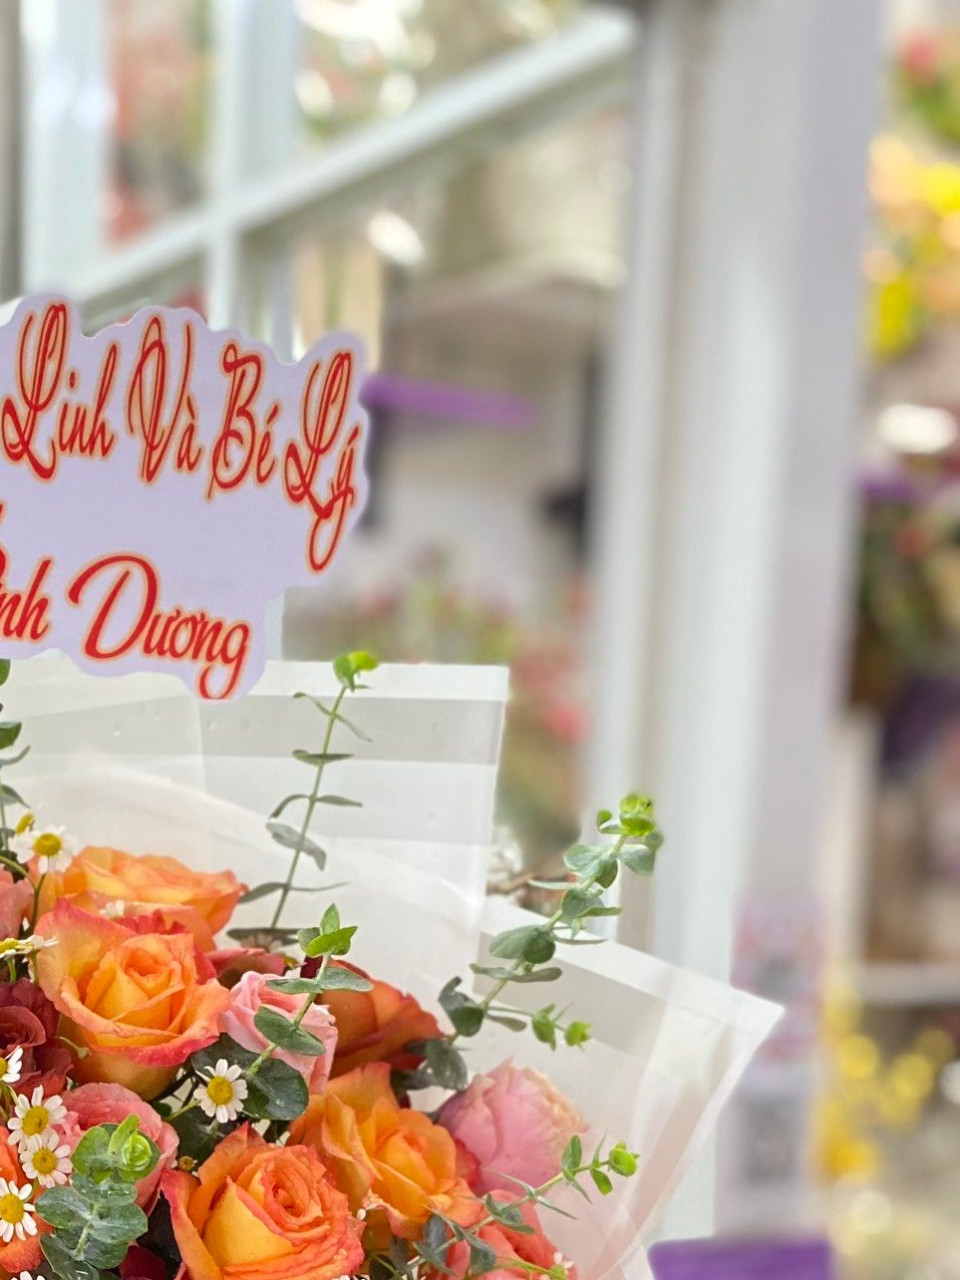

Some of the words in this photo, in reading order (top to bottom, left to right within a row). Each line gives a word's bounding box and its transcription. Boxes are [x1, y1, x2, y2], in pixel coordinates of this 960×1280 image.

[0, 303, 120, 483] Linh
[127, 316, 202, 485] Và
[207, 343, 281, 500] Bé
[284, 352, 362, 574] Lý
[67, 554, 252, 701] Dương
